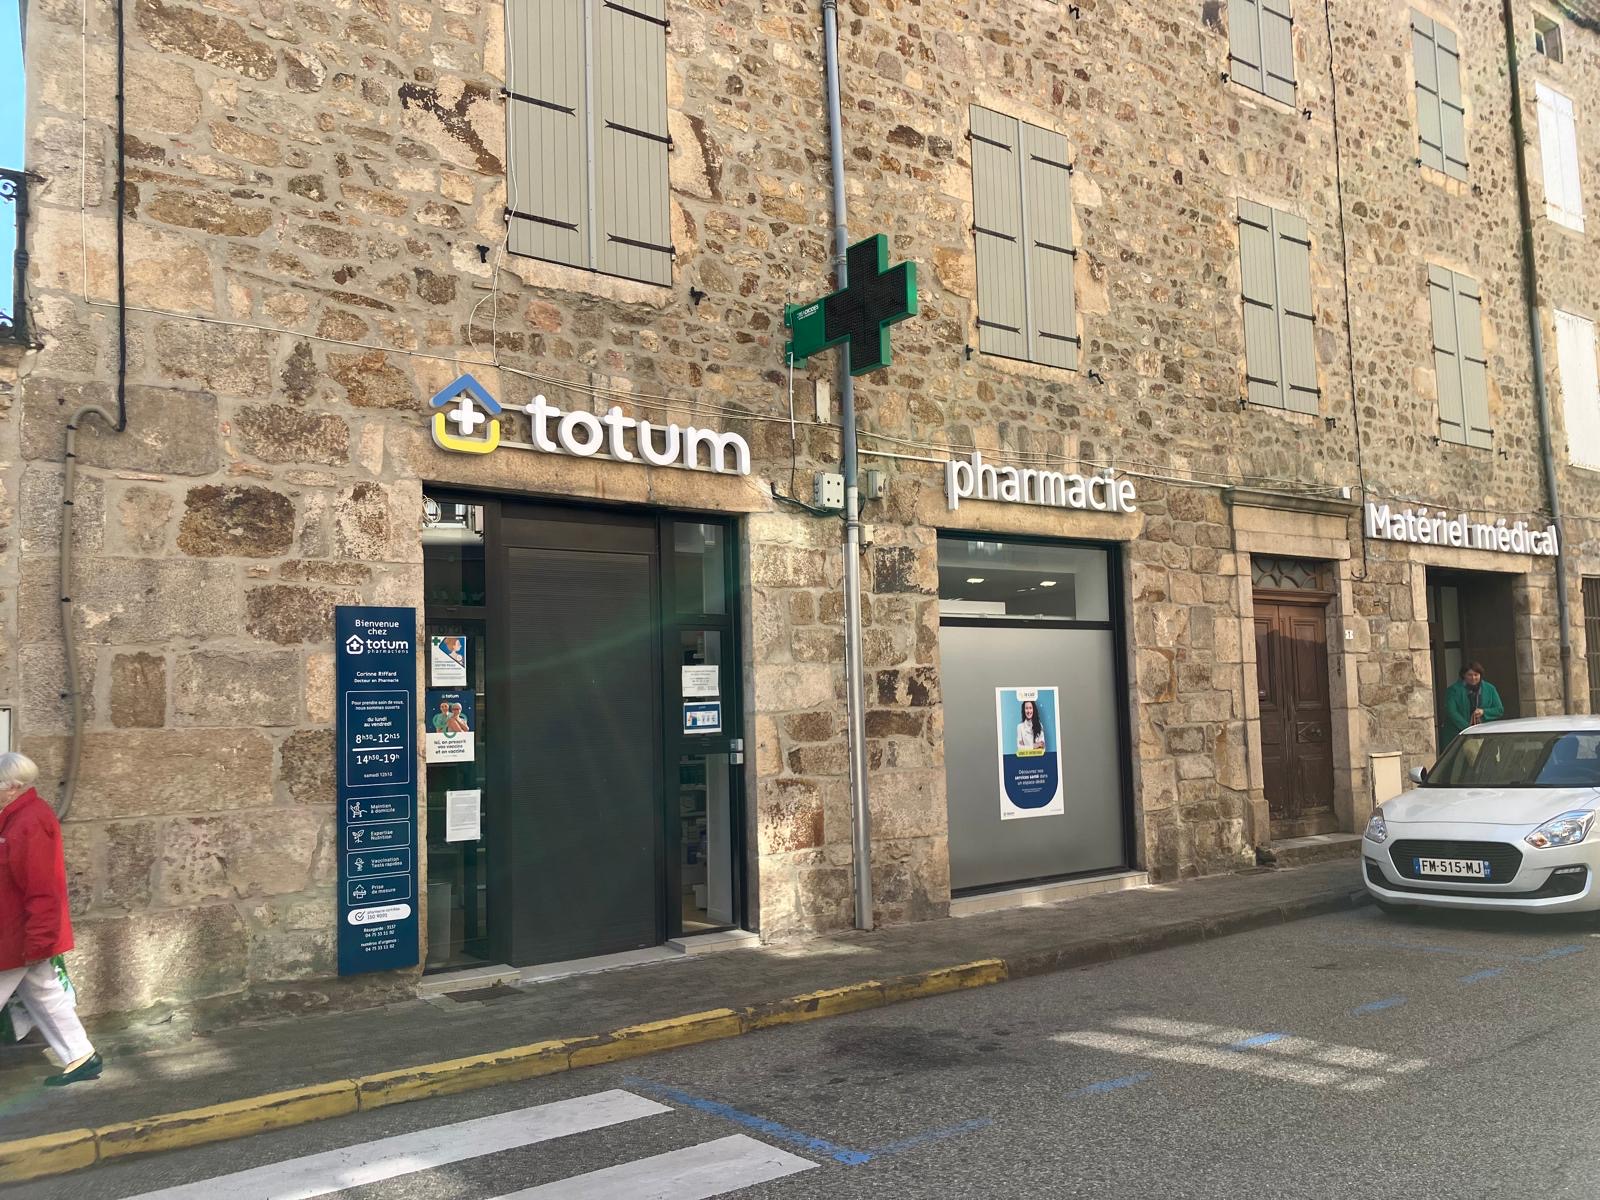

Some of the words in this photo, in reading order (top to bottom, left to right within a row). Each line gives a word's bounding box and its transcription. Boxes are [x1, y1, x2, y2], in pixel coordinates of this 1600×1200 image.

[522, 394, 751, 476] totum
[946, 451, 1137, 513] pharmacie
[1365, 502, 1472, 547] Matériel
[1472, 518, 1559, 556] médical
[355, 619, 400, 628] Bienvenue
[368, 628, 388, 636] chez
[366, 639, 408, 650] totum
[1422, 860, 1481, 874] FM-515-MJ
